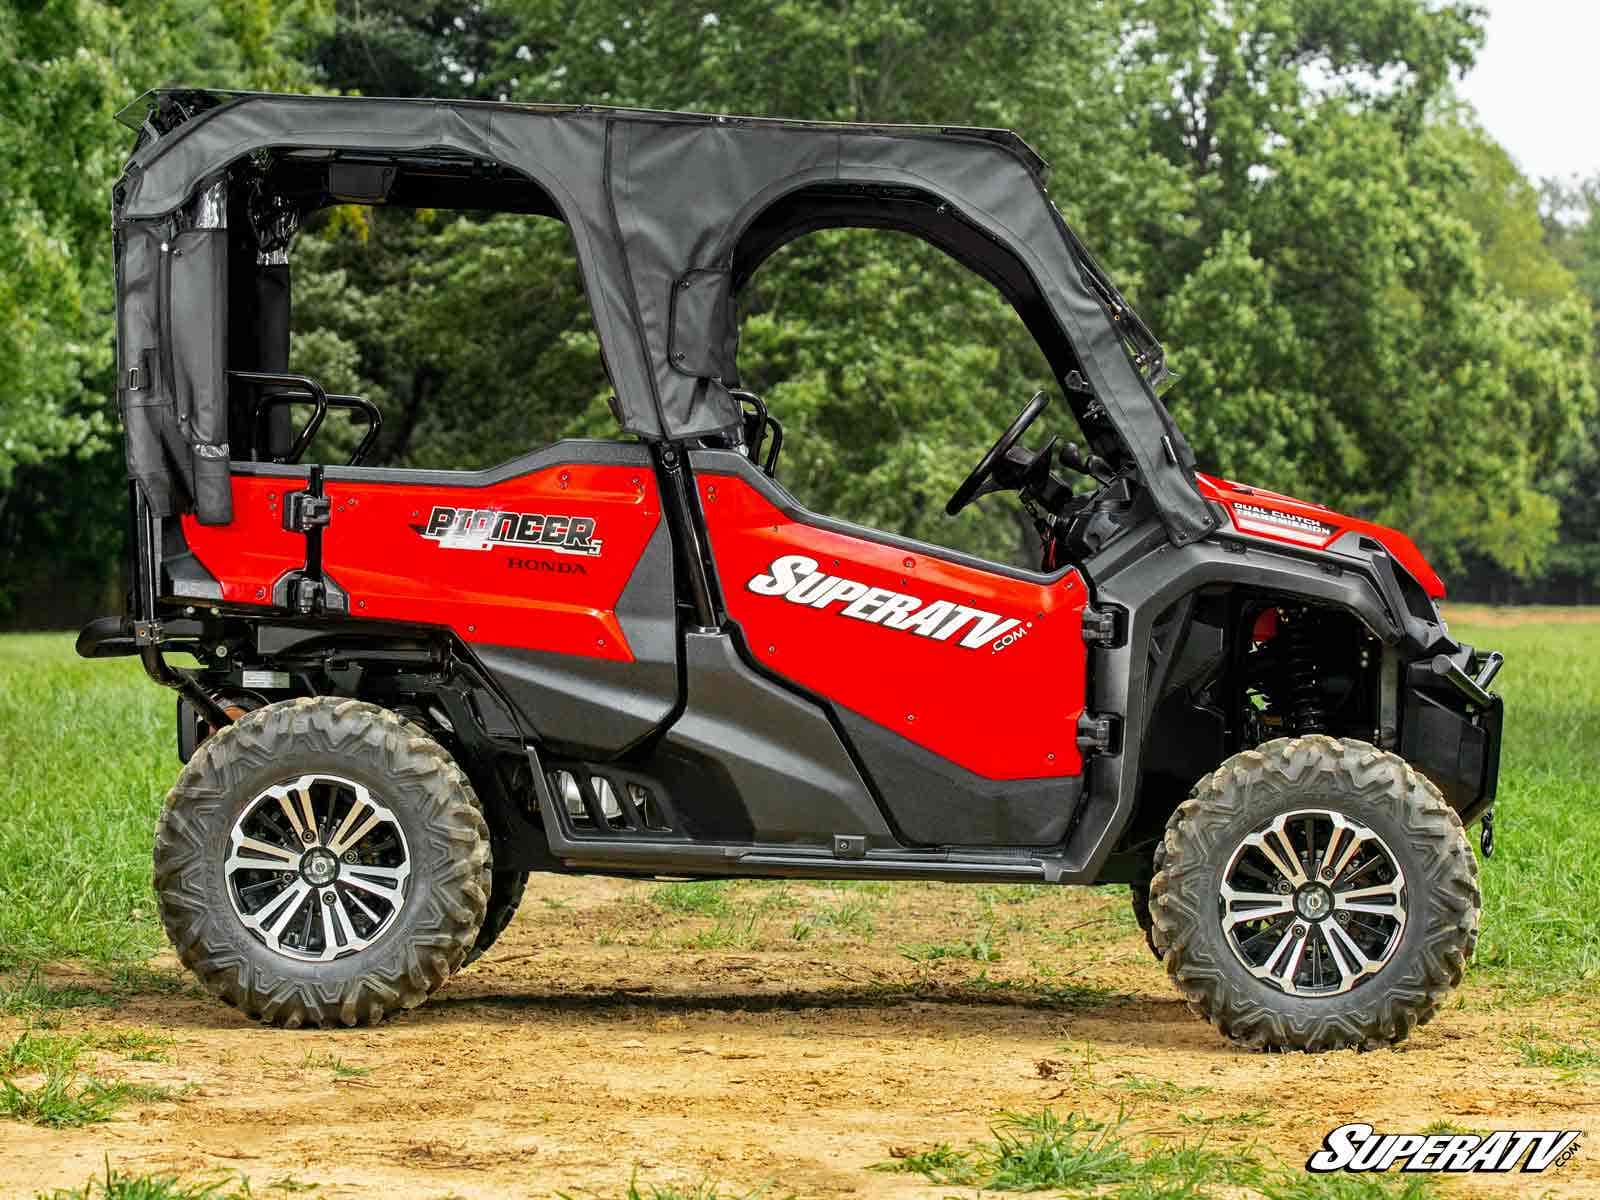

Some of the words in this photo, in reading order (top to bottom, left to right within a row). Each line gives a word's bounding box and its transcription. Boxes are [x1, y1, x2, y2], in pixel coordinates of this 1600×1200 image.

[1232, 502, 1265, 515] DUAL
[1271, 511, 1321, 527] CLUTCH
[507, 558, 588, 575] HONDA
